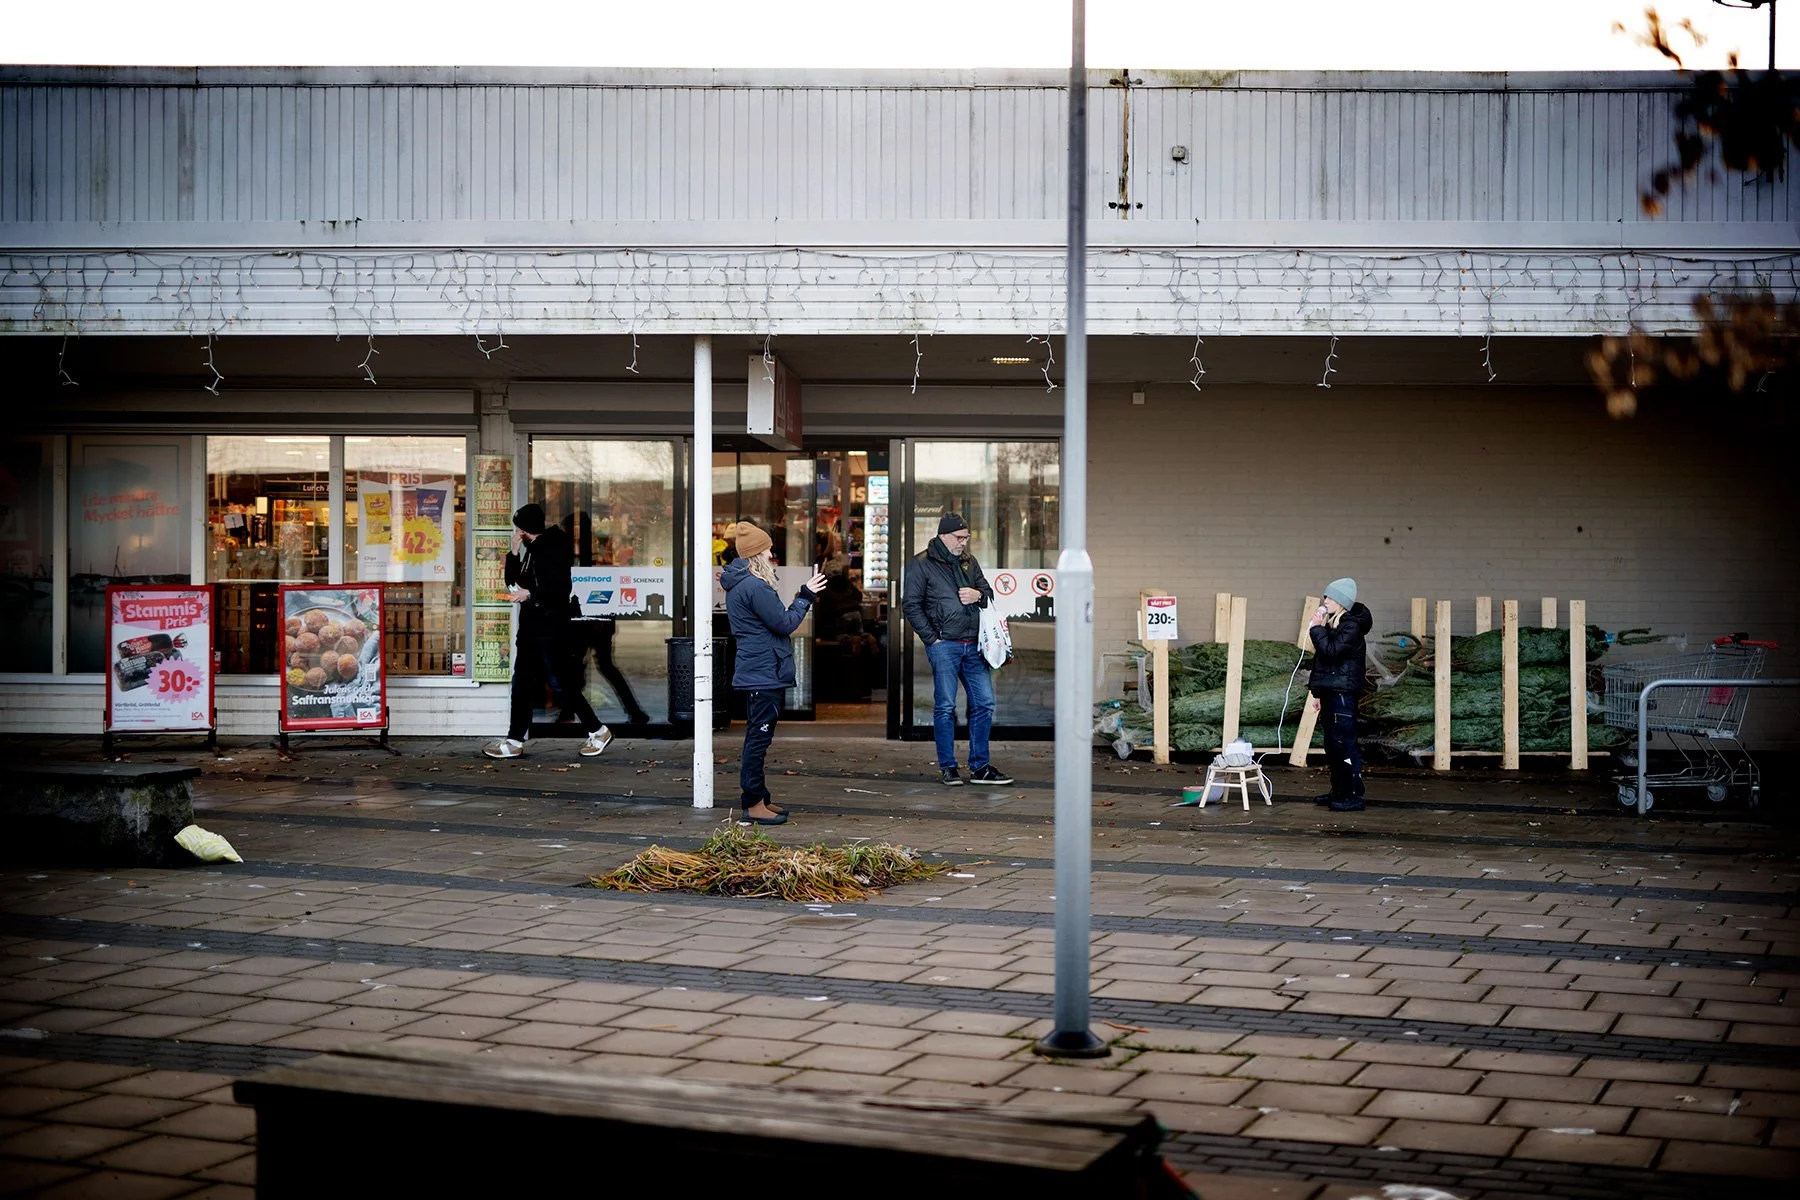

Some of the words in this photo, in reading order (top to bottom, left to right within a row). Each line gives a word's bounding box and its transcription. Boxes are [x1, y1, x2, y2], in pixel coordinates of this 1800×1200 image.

[390, 473, 420, 484] PRIS
[302, 484, 325, 492] Lunch
[125, 601, 198, 618] Stammis
[165, 615, 188, 629] Pris
[1148, 612, 1175, 625] 230:-
[158, 670, 200, 692] 30:-
[292, 694, 376, 705] Saffransmunkar
